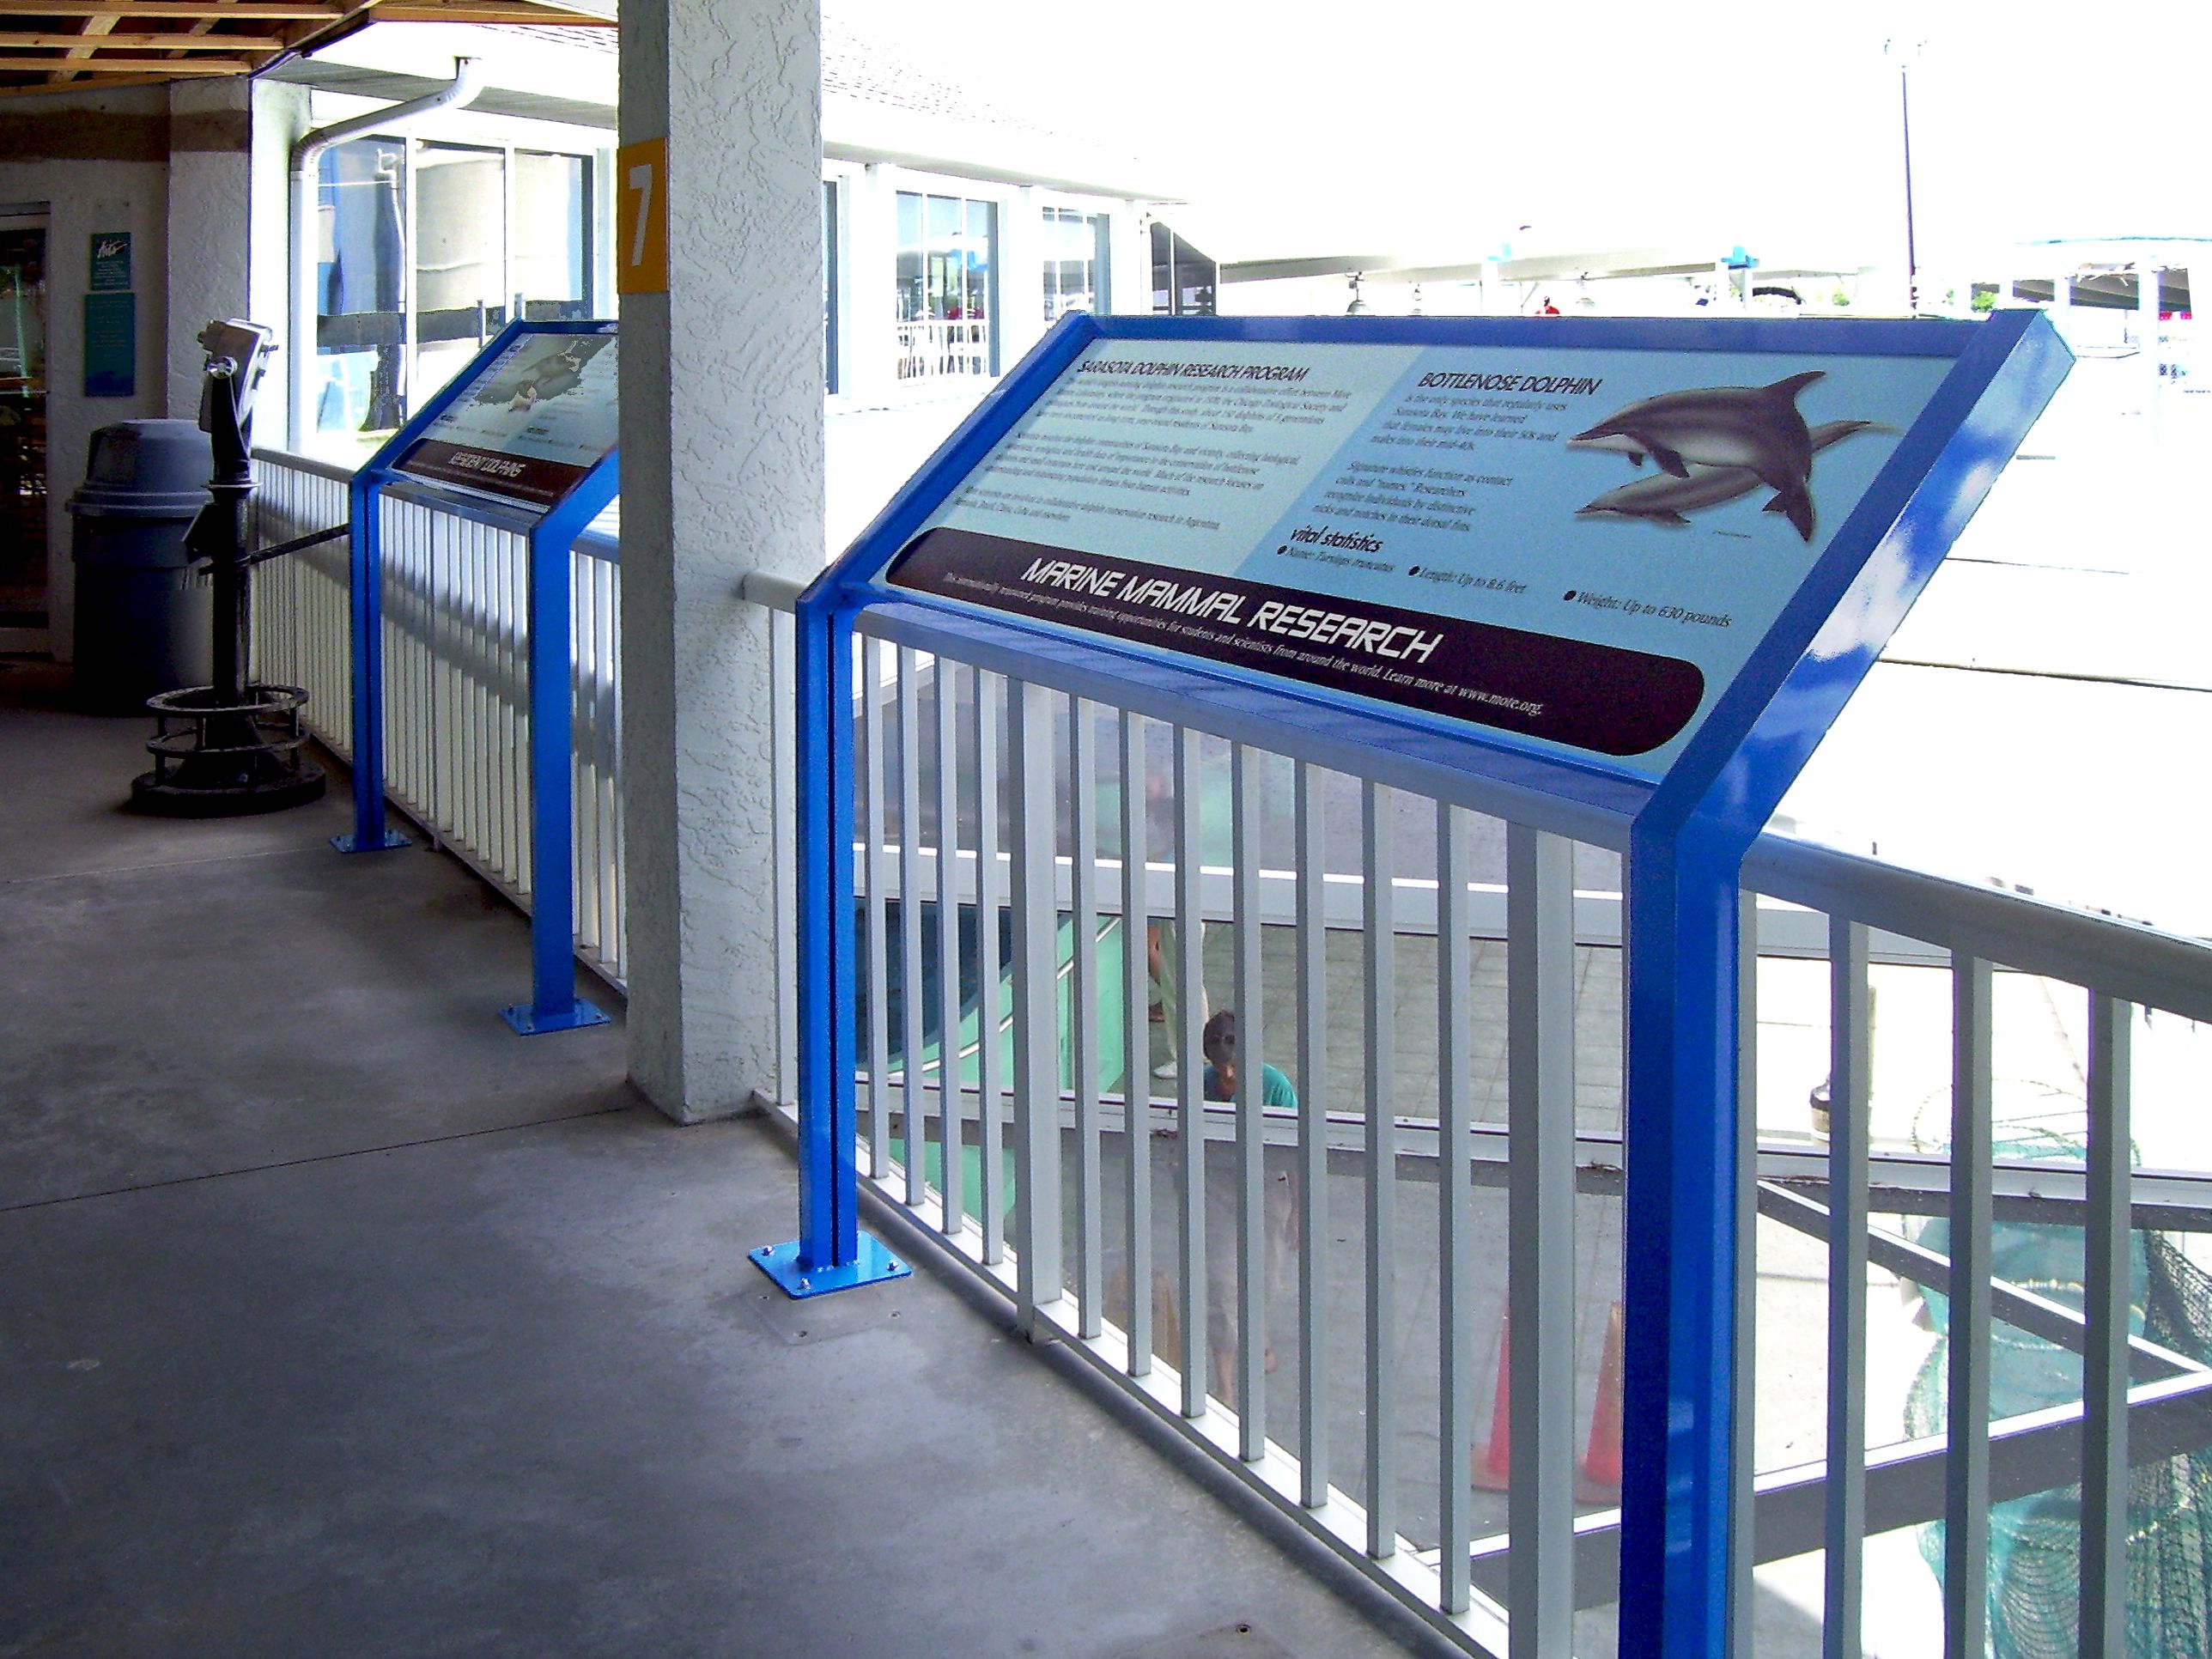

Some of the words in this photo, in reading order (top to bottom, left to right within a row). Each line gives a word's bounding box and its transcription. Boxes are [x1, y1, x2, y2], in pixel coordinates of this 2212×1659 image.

[629, 163, 653, 266] 7
[1077, 360, 1135, 374] SARASOTA
[1130, 362, 1185, 375] DOLPHIN
[1179, 363, 1244, 378] RESEARCH
[1238, 366, 1310, 381] PROGRAM
[1418, 372, 1522, 391] BOTTLENOSE
[1518, 376, 1603, 394] DOLPHIN
[1287, 524, 1328, 544] vital
[1320, 528, 1383, 553] statistics
[1020, 556, 1126, 597] MARINE
[1115, 574, 1257, 624] MAMMAL
[1247, 600, 1444, 663] RESEARCH
[1681, 611, 1733, 626] pounds
[1213, 634, 1235, 644] and
[1273, 645, 1297, 659] from
[1296, 653, 1334, 666] around
[1332, 658, 1350, 671] the
[1349, 664, 1380, 678] world.
[1382, 668, 1414, 685] Learn
[1413, 678, 1443, 691] more
